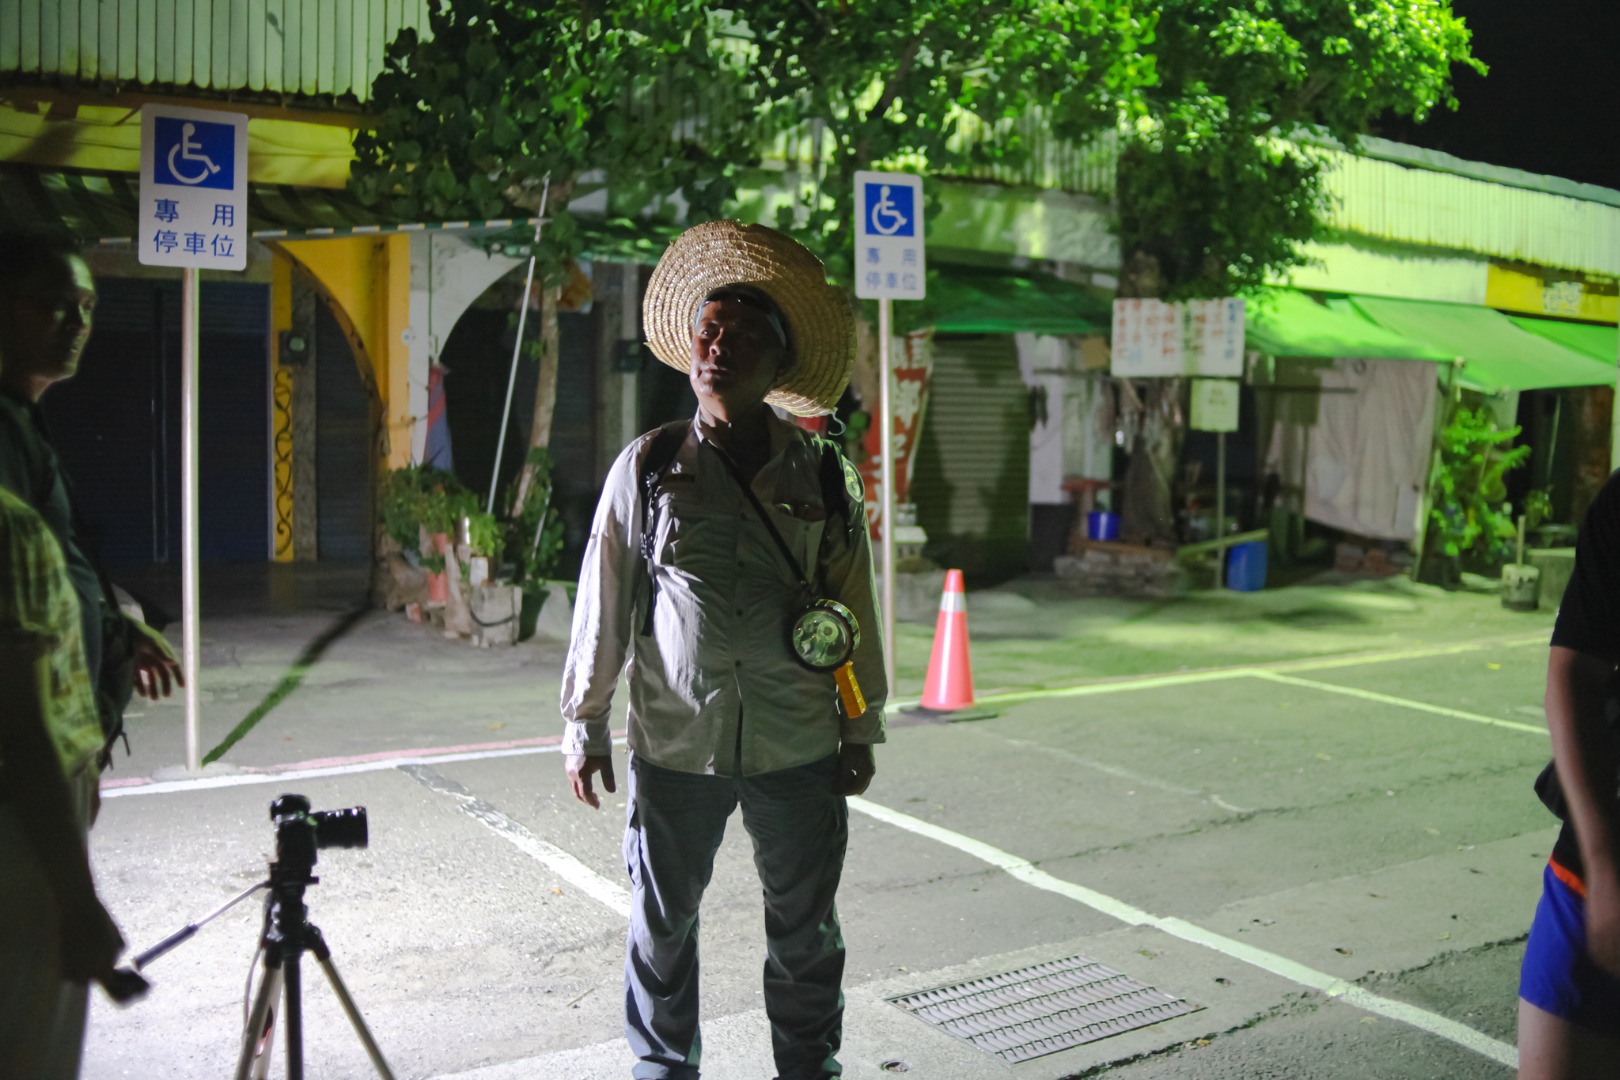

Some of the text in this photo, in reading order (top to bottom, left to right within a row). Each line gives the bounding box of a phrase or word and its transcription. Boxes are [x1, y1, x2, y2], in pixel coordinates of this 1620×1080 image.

[154, 198, 234, 227] 專用
[153, 229, 235, 257] 停車位
